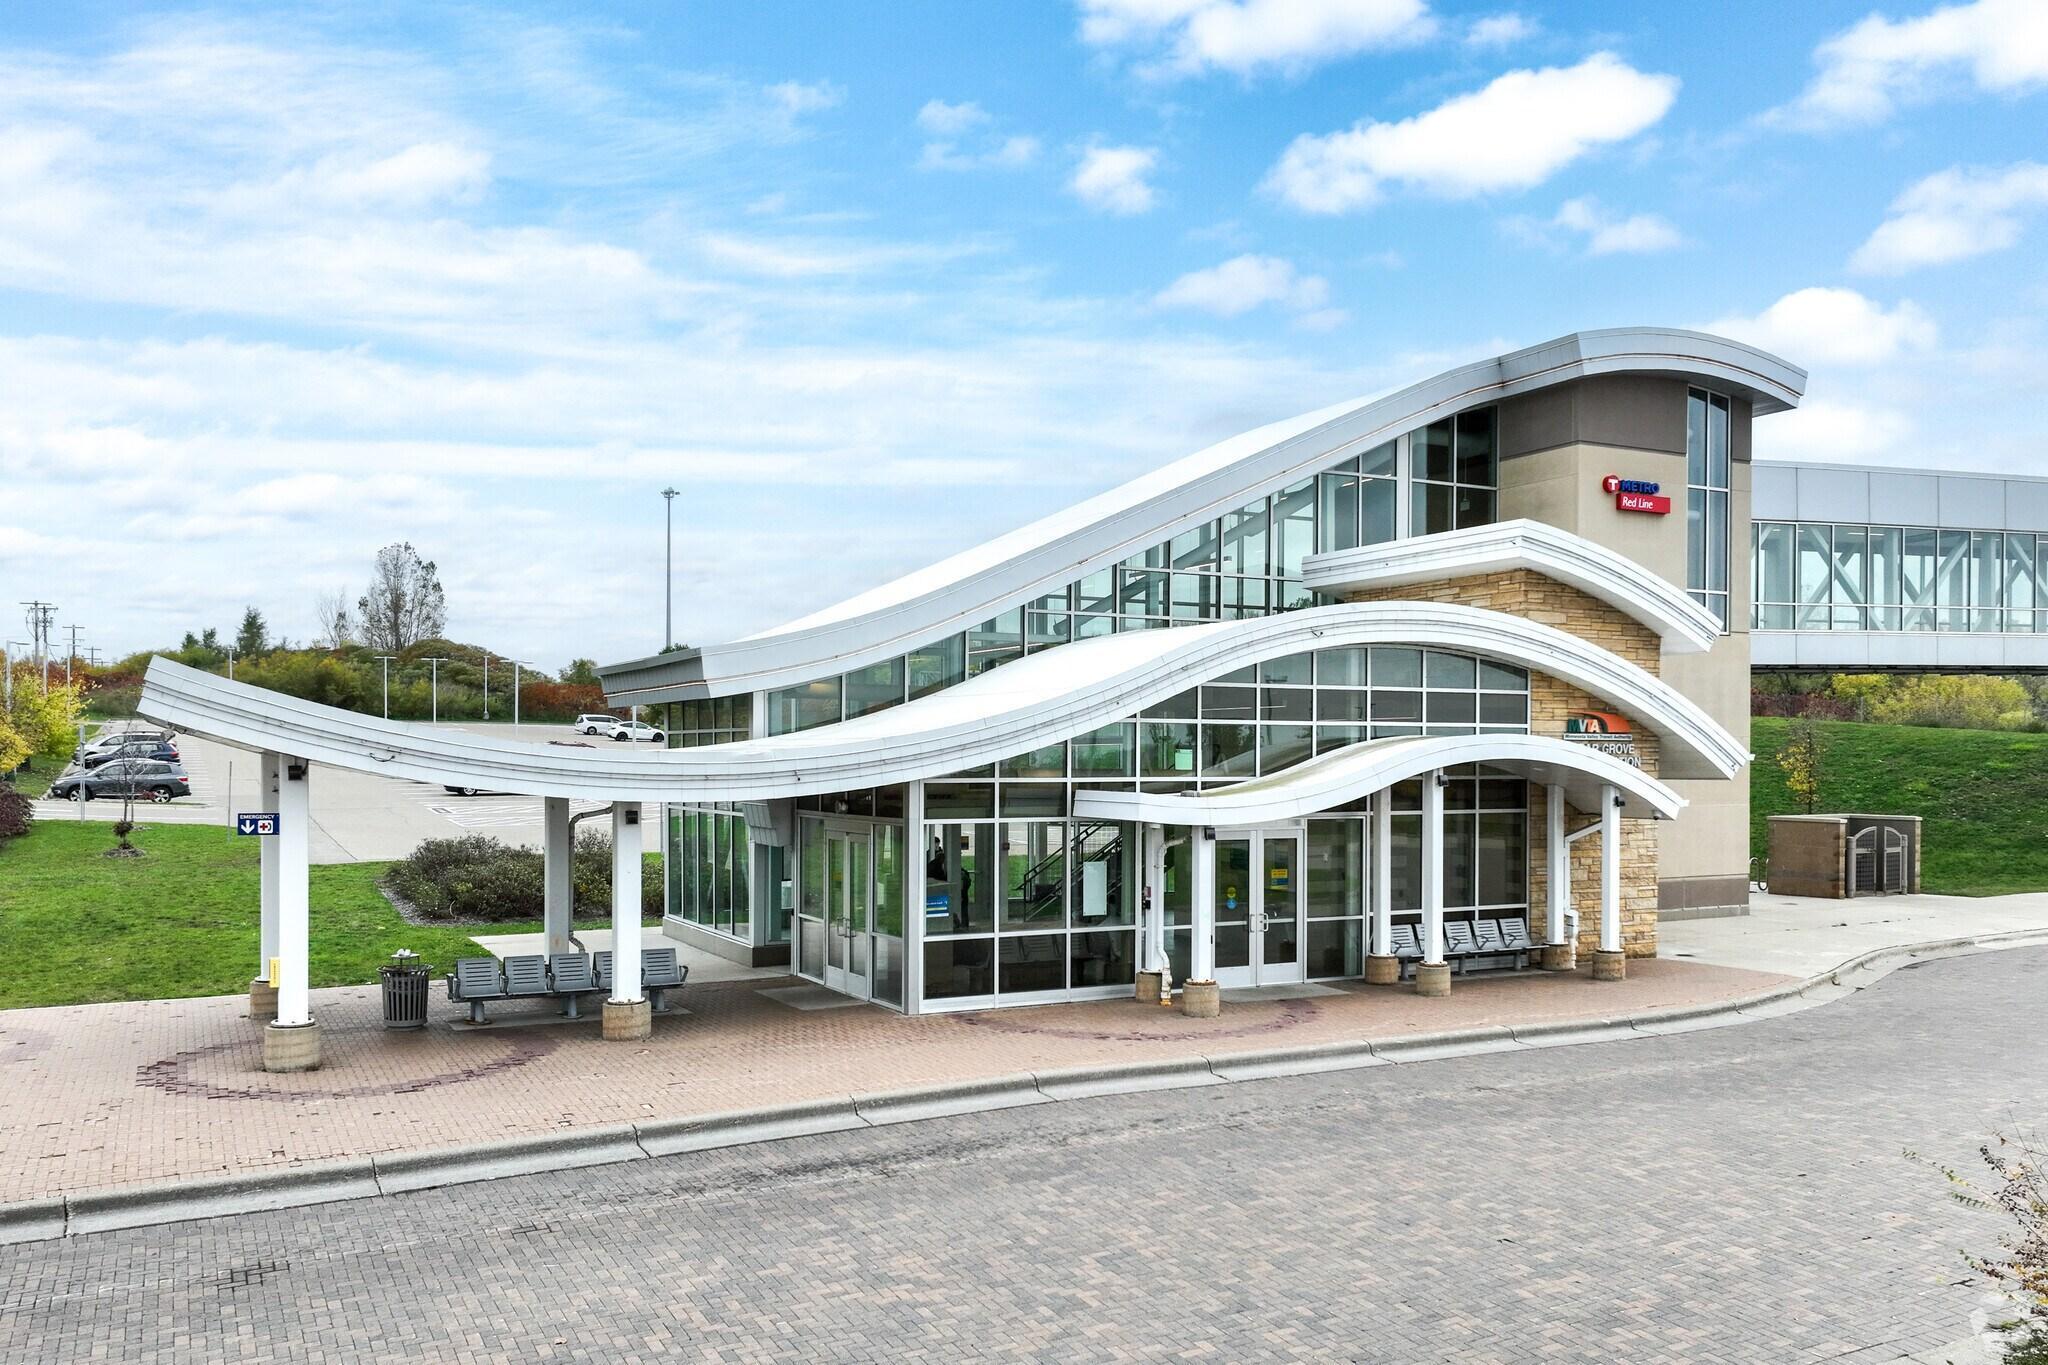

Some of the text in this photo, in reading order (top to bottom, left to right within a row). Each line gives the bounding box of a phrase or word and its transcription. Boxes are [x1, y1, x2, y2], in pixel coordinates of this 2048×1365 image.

[1608, 479, 1659, 494] T METRO
[1622, 496, 1654, 509] Red Line
[1568, 719, 1600, 732] MVTA
[1602, 744, 1634, 754] GROVE
